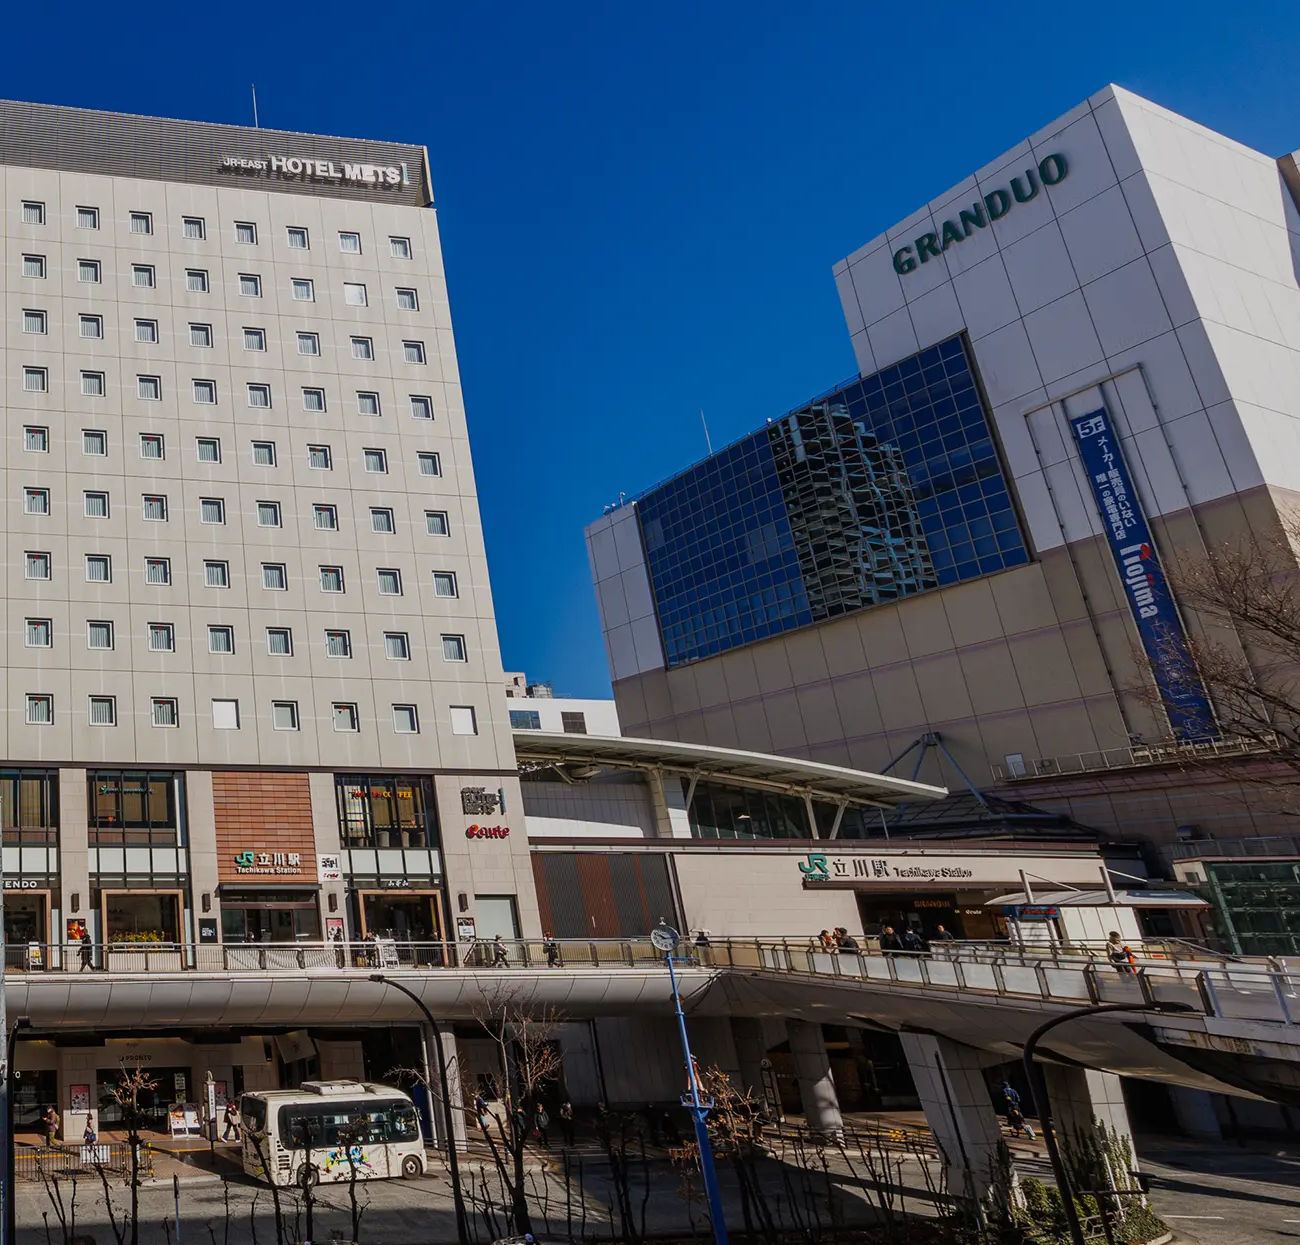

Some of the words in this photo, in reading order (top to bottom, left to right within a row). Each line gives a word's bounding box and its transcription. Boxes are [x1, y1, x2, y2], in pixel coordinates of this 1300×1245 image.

[223, 156, 267, 170] JR-EAST
[271, 155, 342, 178] HOTEL
[344, 163, 400, 184] METS
[893, 153, 1068, 275] GRANDUO
[1080, 420, 1104, 437] 5F
[383, 790, 413, 798] COFEE
[235, 851, 255, 863] JR
[258, 852, 301, 866] 立川駅
[799, 854, 829, 873] JR
[237, 866, 275, 875] Tachikawa
[276, 866, 302, 875] Station
[832, 858, 889, 878] 立川駅
[893, 866, 941, 878] Tachikawa
[942, 867, 972, 878] Station
